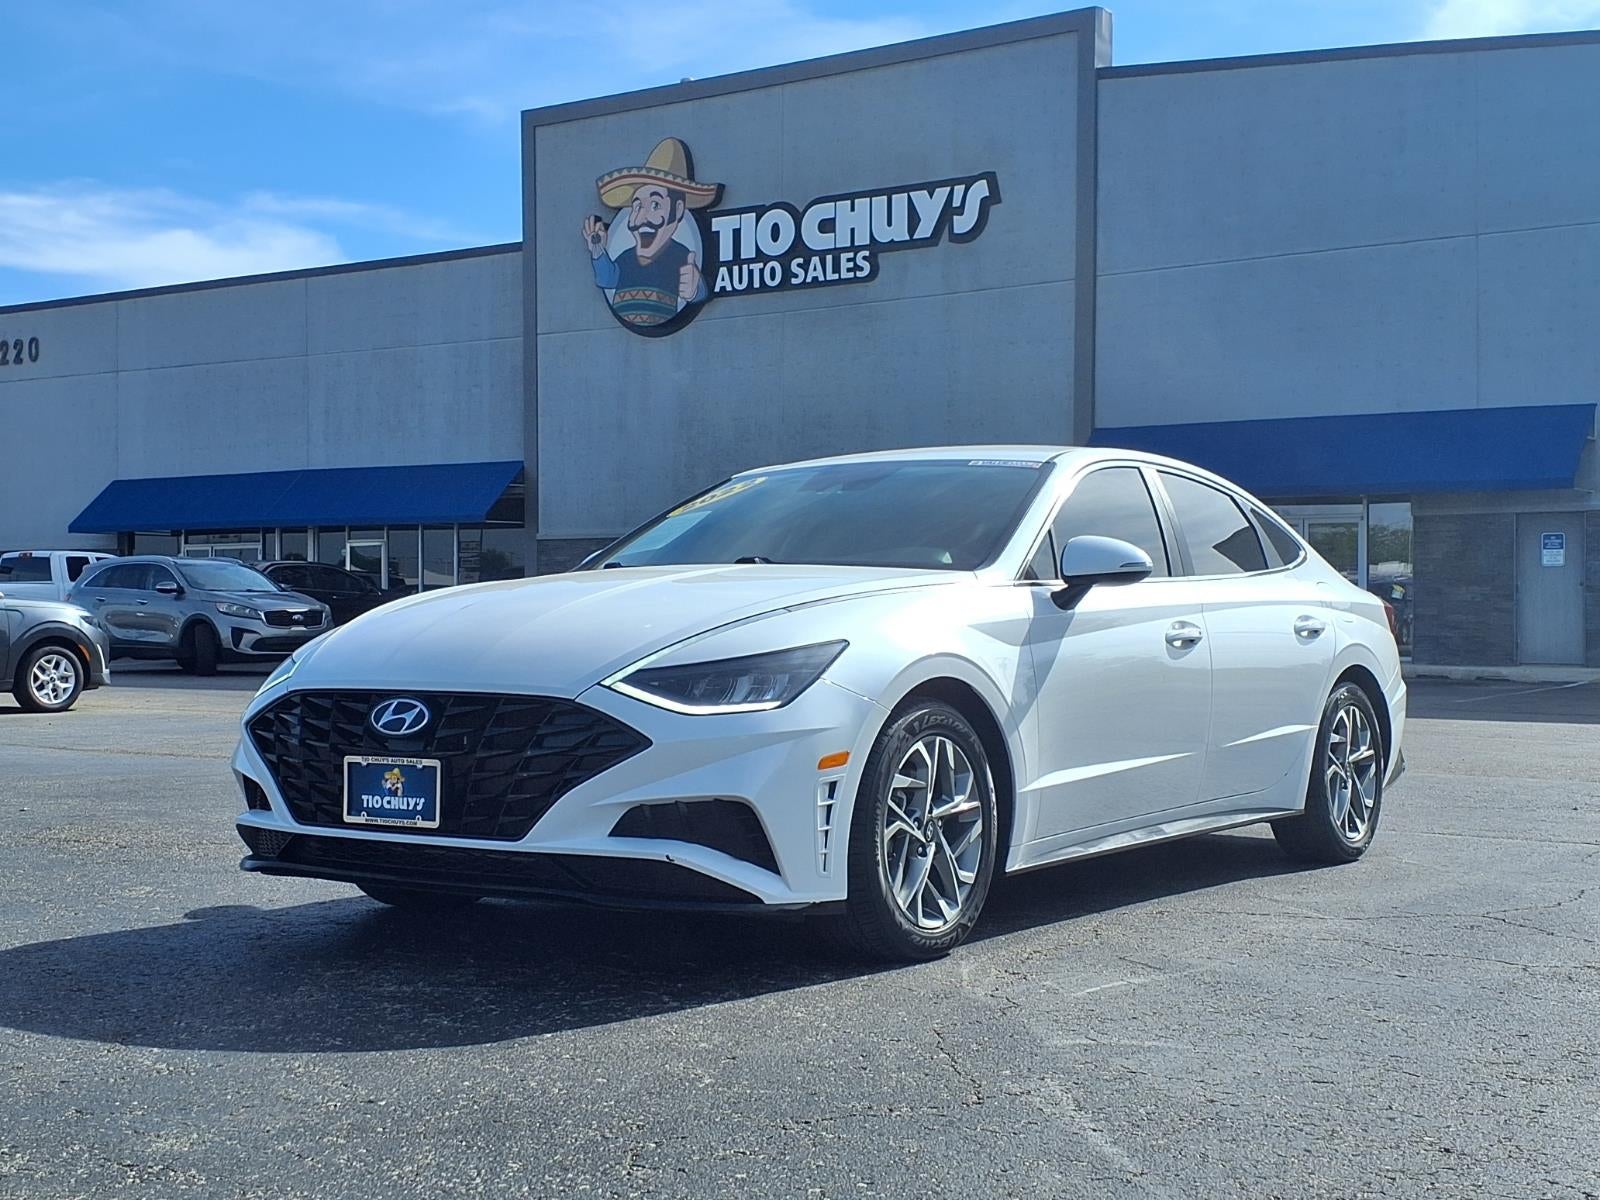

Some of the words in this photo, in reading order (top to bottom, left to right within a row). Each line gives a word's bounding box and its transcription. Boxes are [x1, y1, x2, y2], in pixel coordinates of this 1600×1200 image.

[711, 208, 795, 262] TIO
[801, 179, 990, 250] CHUY'S
[714, 260, 782, 292] AUTO
[790, 250, 871, 285] SALES
[0, 337, 40, 365] 220
[361, 795, 382, 808] TIO
[383, 796, 425, 811] CHUY'S
